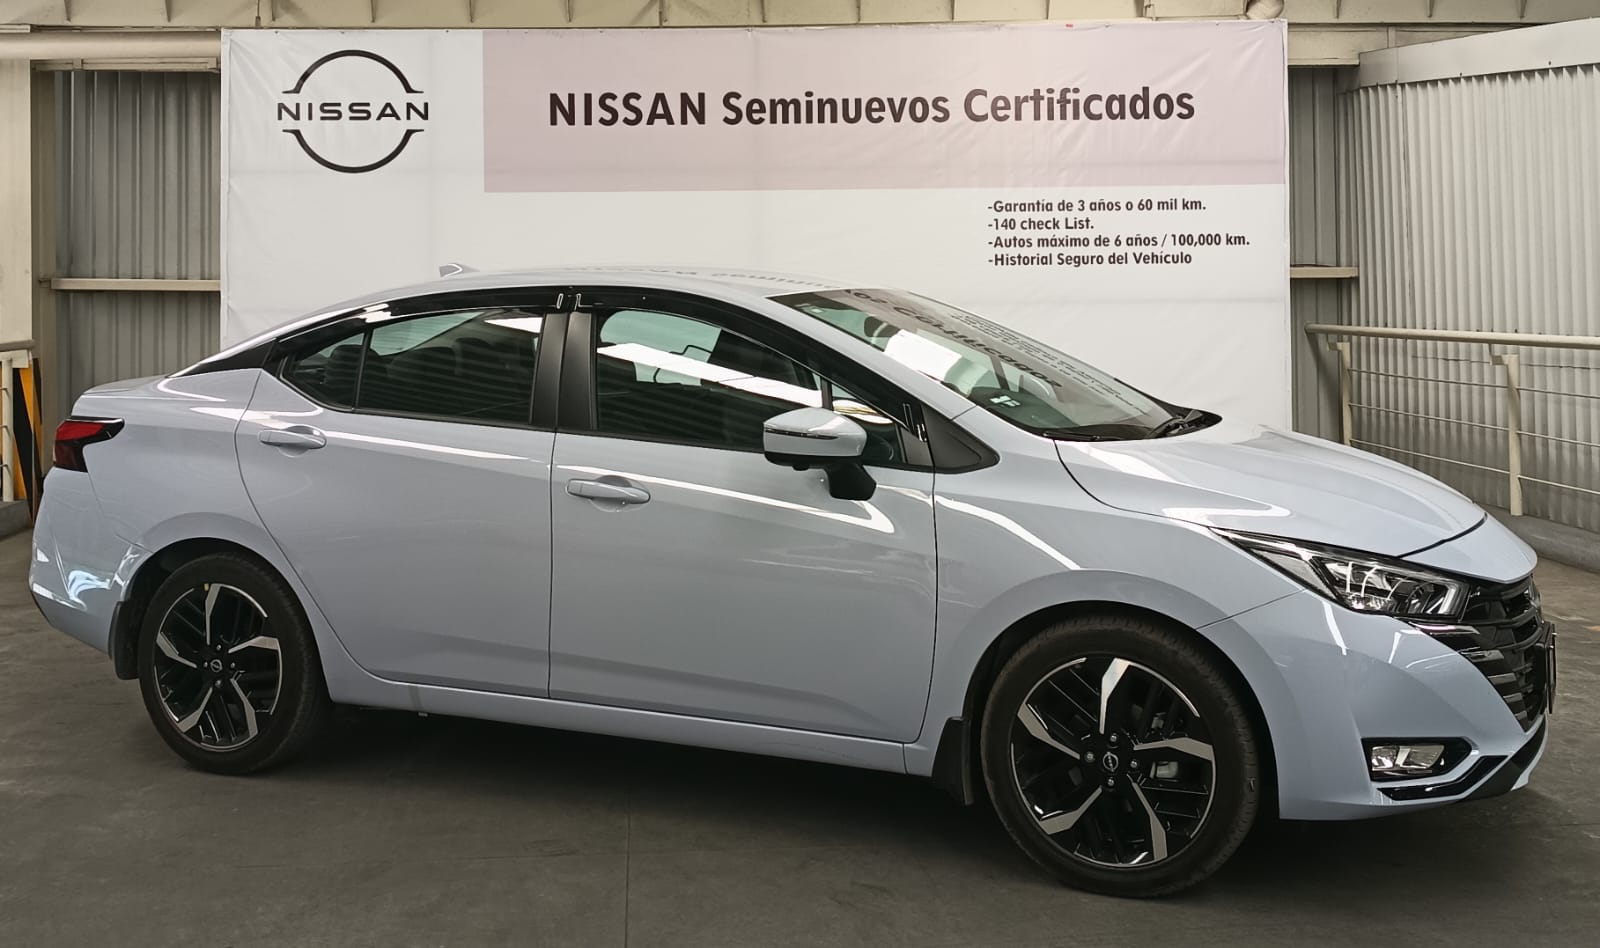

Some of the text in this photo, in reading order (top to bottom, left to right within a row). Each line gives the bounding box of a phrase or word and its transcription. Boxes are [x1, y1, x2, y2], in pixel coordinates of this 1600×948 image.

[277, 101, 429, 121] NISSAN
[549, 86, 1195, 127] NISSAN Seminuevos Certificados
[987, 197, 1207, 213] -Garantía de 3 años o 60 mil km.
[987, 216, 1094, 231] -140 check List.
[988, 235, 1033, 249] -Autos
[1037, 234, 1090, 248] máximo
[1093, 234, 1111, 248] de
[1114, 234, 1122, 247] 6
[1125, 233, 1159, 247] años
[1171, 233, 1222, 248] 100,000
[1225, 232, 1250, 246] km.
[988, 250, 1192, 268] -Historial Seguro del Vehículo
